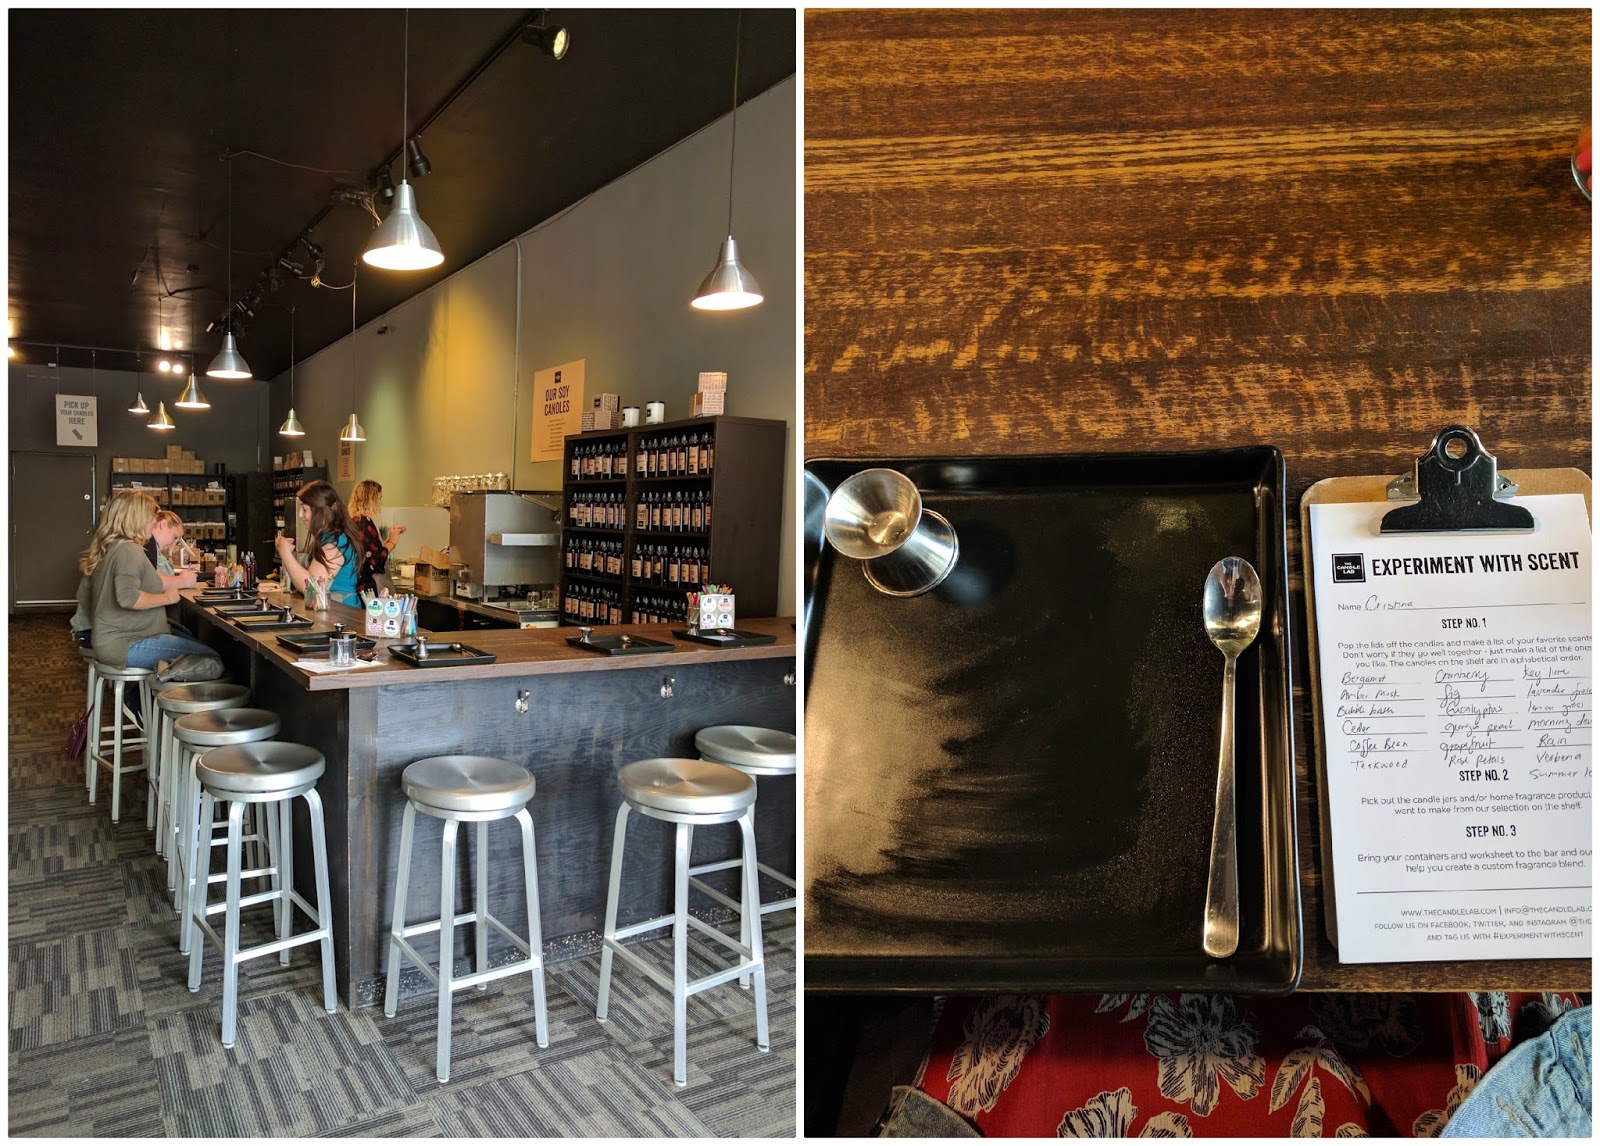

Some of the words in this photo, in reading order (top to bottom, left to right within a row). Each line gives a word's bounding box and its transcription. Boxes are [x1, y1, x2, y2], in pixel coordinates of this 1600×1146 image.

[545, 388, 557, 402] OUR
[558, 385, 570, 399] SOY
[63, 401, 79, 409] PICK
[80, 401, 90, 409] UP
[544, 400, 570, 416] CANDLES
[68, 417, 86, 425] HERE
[1372, 556, 1474, 576] EXPERIMENT
[1479, 554, 1523, 573] WITH
[1527, 552, 1579, 570] SCENT
[1441, 618, 1463, 629] STEP
[1466, 618, 1481, 628] NO.
[1414, 640, 1444, 648] candles
[1366, 651, 1388, 659] worry
[1398, 650, 1416, 658] they
[1448, 648, 1482, 656] together
[1489, 648, 1504, 656] just
[1406, 658, 1436, 666] candles
[1466, 657, 1484, 665] shelf
[1510, 655, 1558, 664] alphabetical
[1540, 734, 1567, 748] Rain
[1350, 738, 1378, 758] Coffee
[1459, 770, 1482, 782] STEP
[1484, 769, 1500, 780] NO.
[1502, 768, 1510, 780] 2
[1529, 768, 1578, 780] Summer
[1361, 796, 1378, 804] Pick
[1397, 796, 1410, 804] the
[1412, 795, 1440, 804] candle
[1442, 795, 1458, 804] jars
[1460, 794, 1488, 802] and/or
[1515, 792, 1556, 801] fragrance
[1428, 806, 1451, 814] make
[1492, 804, 1530, 812] selection
[1544, 802, 1560, 810] the
[1561, 801, 1584, 810] shelf.
[1466, 826, 1490, 838] STEP
[1492, 825, 1508, 836] NO.
[1510, 824, 1517, 836] 3
[1358, 854, 1381, 864] Bring
[1383, 855, 1402, 863] your
[1404, 852, 1449, 861] containers
[1450, 852, 1468, 860] and
[1470, 850, 1514, 860] worksheet
[1527, 849, 1542, 858] the
[1544, 848, 1558, 857] bar
[1560, 848, 1578, 856] and
[1406, 864, 1425, 873] help
[1427, 864, 1444, 873] you
[1445, 863, 1472, 872] create
[1482, 862, 1514, 870] custom
[1516, 860, 1557, 870] fragrance
[1559, 860, 1586, 868] blend.
[1400, 908, 1496, 916] WWW.THECANDLELAB.COM
[1526, 918, 1566, 926] INSTAGRAM
[1493, 932, 1584, 940] #EXPERIMENTWITHSCENT
